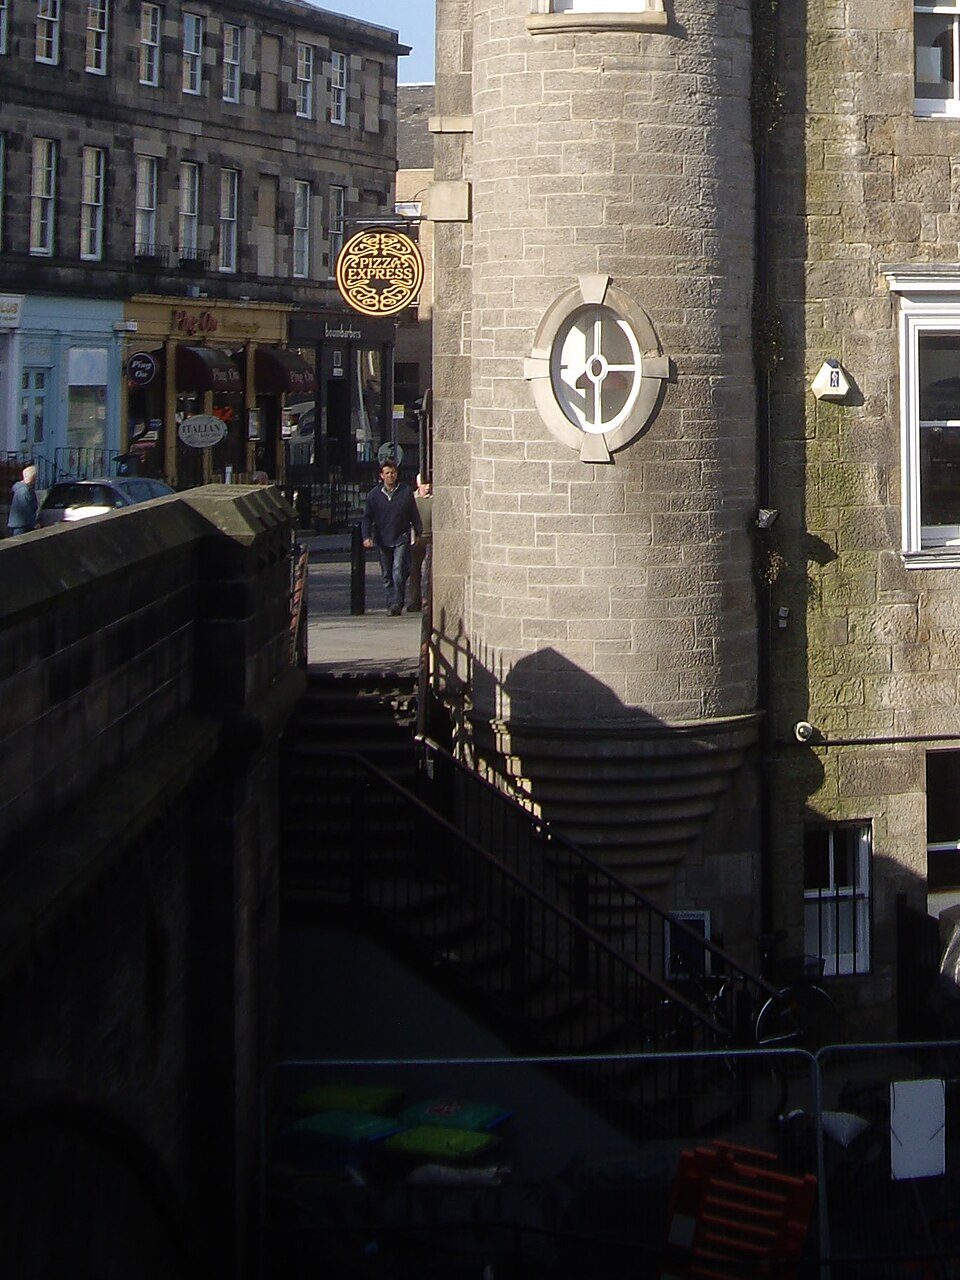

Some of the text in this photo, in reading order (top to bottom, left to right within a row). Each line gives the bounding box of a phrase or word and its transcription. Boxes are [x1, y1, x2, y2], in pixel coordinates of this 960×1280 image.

[359, 257, 402, 269] PIZZA
[347, 268, 413, 280] EXPRESS
[131, 360, 152, 370] Ping
[181, 423, 221, 434] ITALIAN
